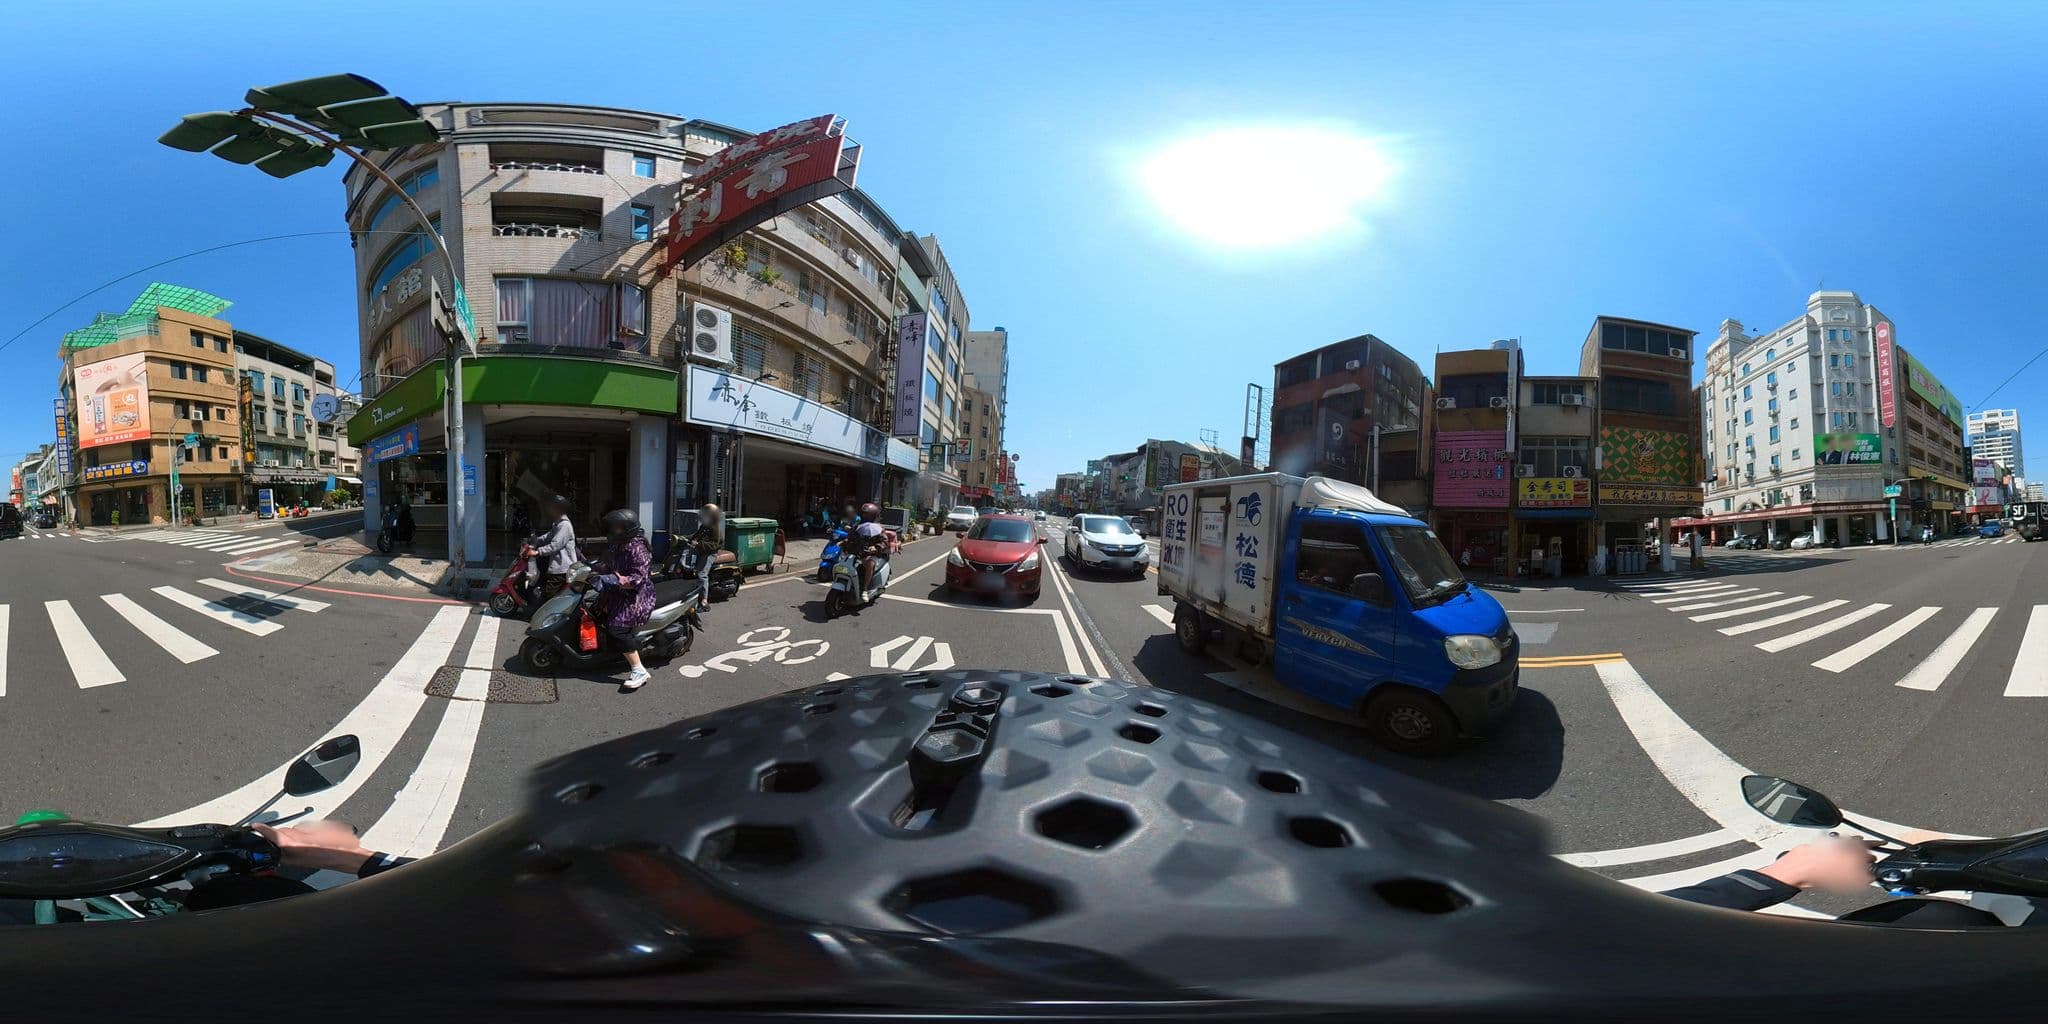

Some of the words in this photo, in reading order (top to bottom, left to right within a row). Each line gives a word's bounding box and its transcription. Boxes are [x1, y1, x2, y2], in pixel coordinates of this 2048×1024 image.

[1167, 494, 1188, 516] RO
[1165, 518, 1187, 541] 衛生
[1235, 532, 1258, 589] 松德
